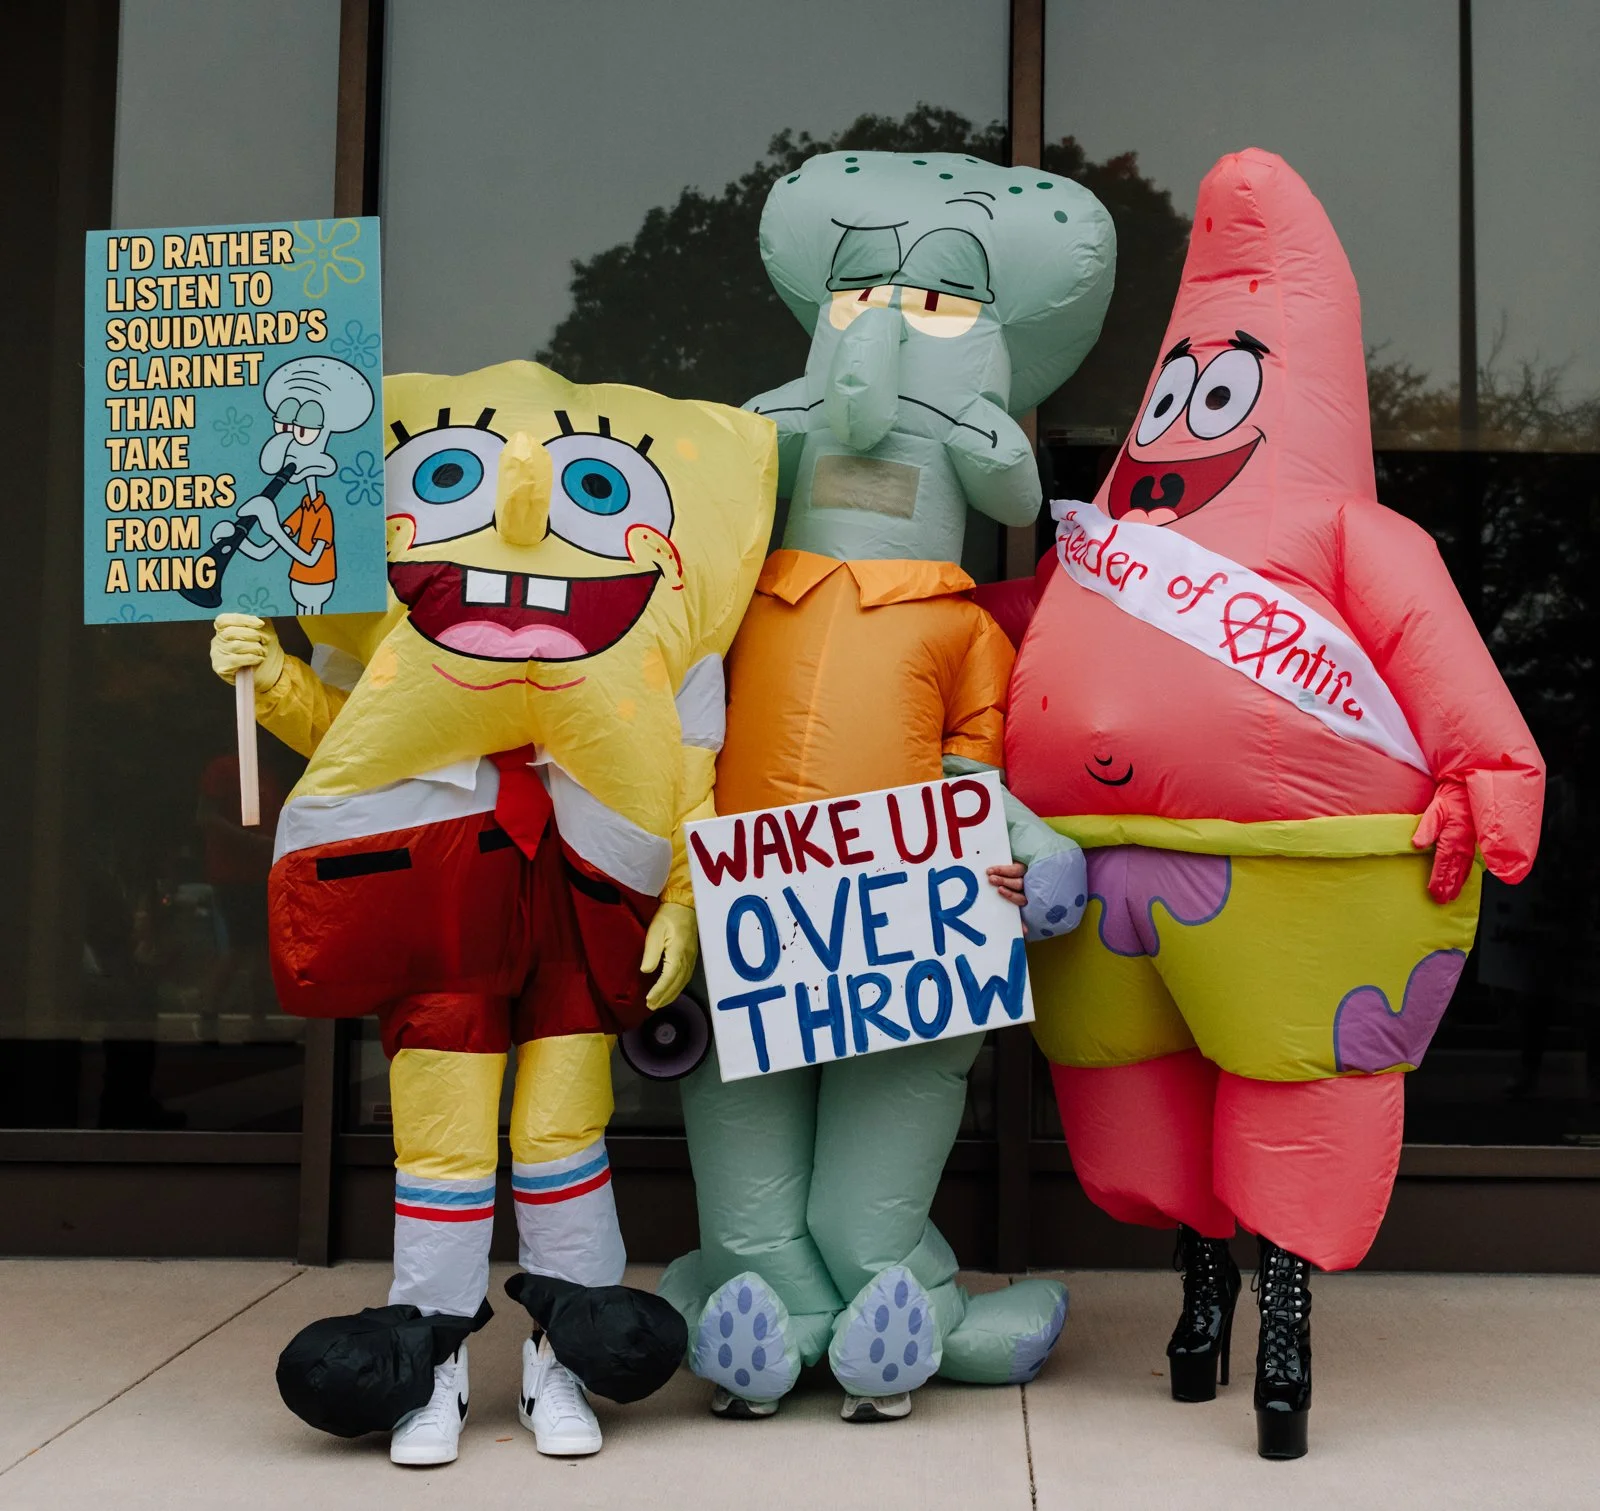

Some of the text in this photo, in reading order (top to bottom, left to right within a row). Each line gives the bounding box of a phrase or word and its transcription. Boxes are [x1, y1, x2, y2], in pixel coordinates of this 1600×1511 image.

[107, 229, 294, 272] I'D RATHER
[106, 271, 272, 312] LISTEN TO
[105, 308, 328, 354] SQUIDWARD'S
[105, 352, 264, 391] CLARINET
[105, 395, 195, 431] THAN
[105, 436, 189, 472] TAKE
[105, 473, 237, 512] ORDERS
[105, 515, 201, 552] FROM
[104, 556, 217, 594] A KING
[1167, 573, 1229, 615] of
[1219, 592, 1365, 721] Antifa
[690, 779, 991, 886] WAKE UP
[726, 865, 986, 982] OVER
[717, 937, 1026, 1073] THROW
